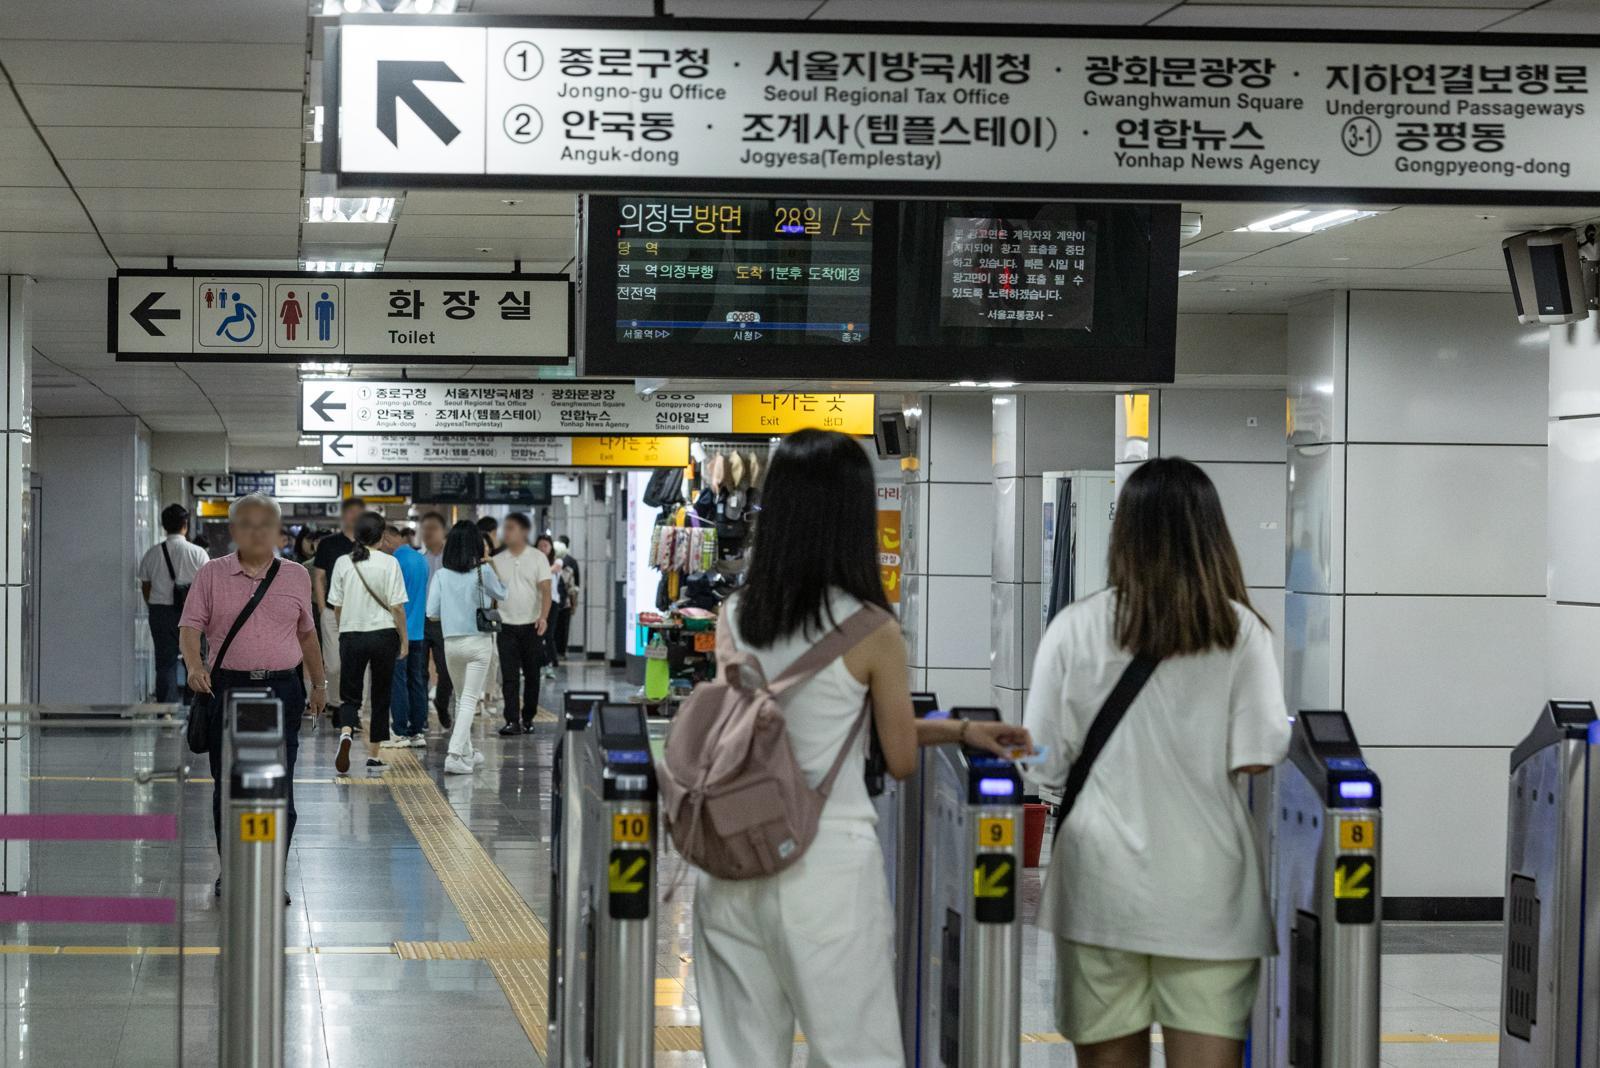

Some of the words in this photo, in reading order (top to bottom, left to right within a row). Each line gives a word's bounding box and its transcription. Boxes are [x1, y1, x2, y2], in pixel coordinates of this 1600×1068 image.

[559, 47, 709, 79] 종로구청
[766, 49, 1030, 84] 서울지방국세청
[1085, 55, 1275, 88] 광화문광장
[1326, 63, 1588, 96] 지하연결보행로
[557, 83, 664, 102] Jongno-gu
[669, 84, 726, 101] Office
[764, 85, 817, 103] Seoul
[825, 87, 907, 105] Regional
[915, 88, 946, 103] Tax
[954, 89, 1009, 105] Office
[1083, 90, 1231, 109] Gwanghwamun
[1237, 93, 1304, 112] Square
[1326, 99, 1450, 118] Underground
[1457, 100, 1585, 119] Passageways
[562, 110, 675, 142] 안국동
[741, 113, 1057, 151] 조계사(템플스테이)
[1115, 119, 1264, 152] 연합뉴스
[1395, 121, 1506, 153] 공평동
[561, 145, 679, 165] Anguk-dong
[740, 149, 942, 170] Jogyesa(Templestay)
[1114, 152, 1184, 171] Yonhap
[1192, 154, 1244, 171] News
[1250, 155, 1320, 174] Agency
[1395, 156, 1570, 177] Gongpyeong-dong
[620, 203, 742, 233] 의정부방면
[775, 207, 822, 235] 28일
[851, 209, 872, 235] 수
[1013, 230, 1051, 240] 계약자와
[1057, 231, 1086, 241] 계약이
[1001, 244, 1021, 254] 광고
[1028, 245, 1058, 255] 표출을
[1065, 245, 1085, 256] 중단
[953, 259, 972, 268] 하고
[979, 259, 1018, 269] 있습니다.
[1024, 259, 1044, 269] 빠른
[1049, 259, 1068, 270] 시일
[1074, 259, 1085, 270] 내
[736, 266, 763, 280] 도착
[770, 267, 802, 280] 1분후
[808, 267, 860, 282] 도착예정
[952, 272, 991, 284] 광고면이
[998, 273, 1018, 285] 정상
[1026, 274, 1047, 285] 표출
[1072, 275, 1084, 286] 수
[617, 286, 657, 301] 전전역
[952, 287, 983, 299] 있도록
[987, 288, 1062, 300] 노력하겠습니다.
[987, 309, 1044, 321] 서울교통공사
[388, 330, 435, 344] Toilet
[623, 330, 653, 340] 서울역
[733, 331, 752, 341] 시청
[842, 332, 862, 342] 종각
[376, 388, 426, 399] 종로구청
[445, 388, 534, 400] 서울지방국세청
[551, 389, 616, 400] 광화문광장
[377, 409, 415, 419] 안국동
[435, 409, 542, 422] 조계사(템플스테이)
[560, 410, 611, 421] 연합뉴스
[656, 412, 710, 424] 신아일보
[760, 416, 780, 426] Exit
[824, 417, 843, 426] 出口
[246, 818, 270, 837] 11
[619, 819, 645, 837] 10
[990, 824, 1003, 842] 9
[1351, 825, 1364, 843] 8
